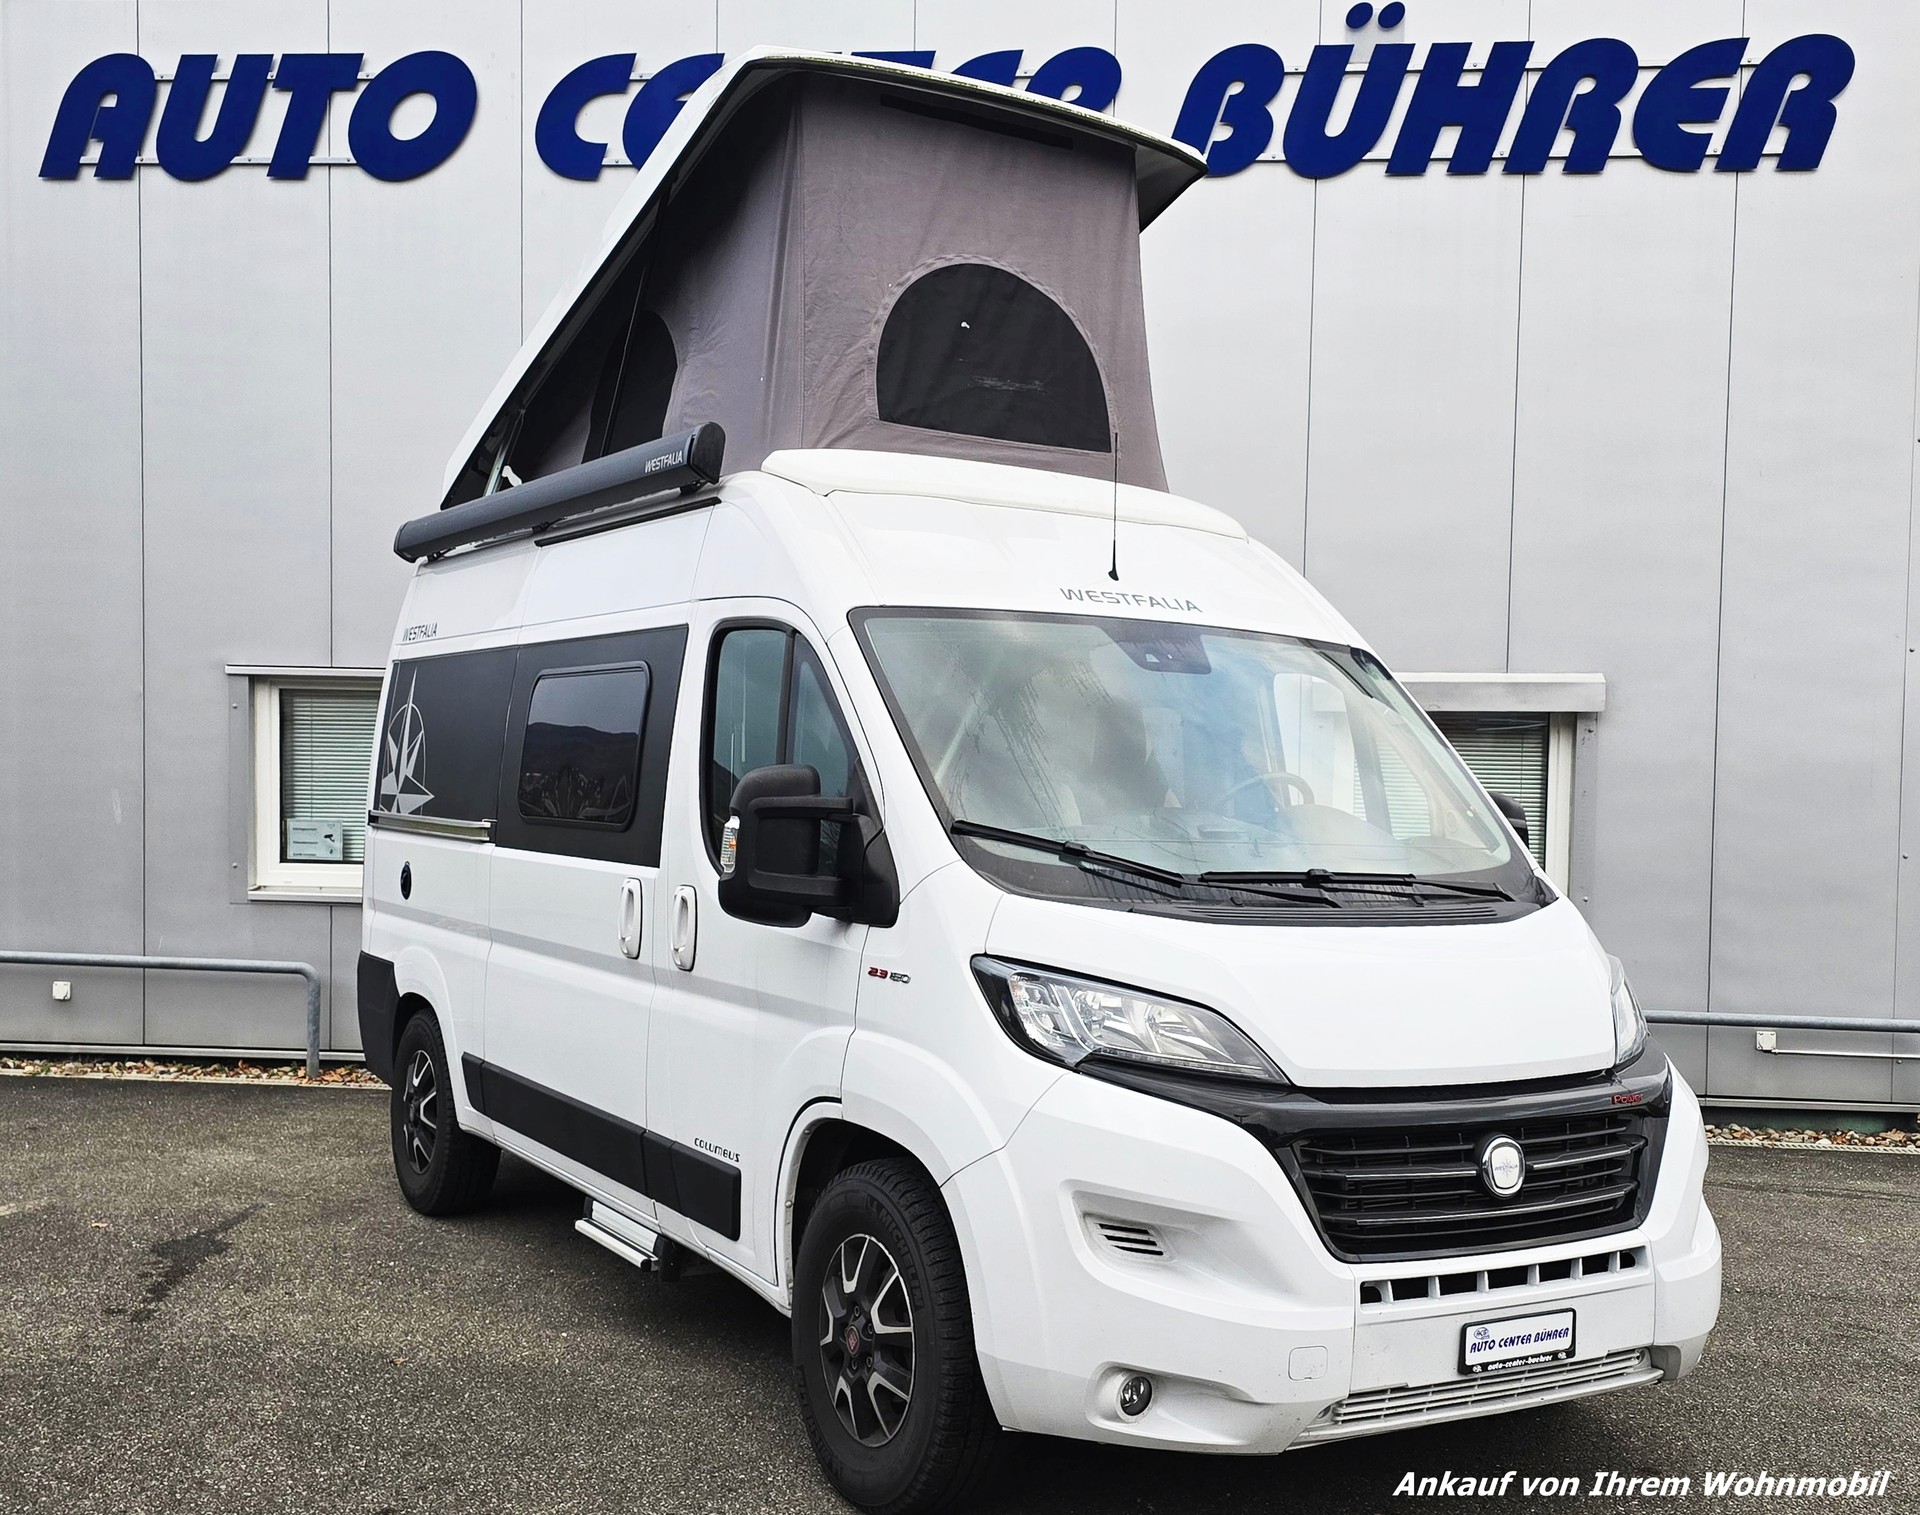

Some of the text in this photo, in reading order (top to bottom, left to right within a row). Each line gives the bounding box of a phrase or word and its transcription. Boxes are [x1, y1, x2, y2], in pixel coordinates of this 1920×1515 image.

[38, 50, 477, 182] AUTO
[1171, 1, 1855, 179] BÜHRER
[644, 450, 683, 474] WESTFALIA
[1059, 587, 1204, 614] WESTFALIA
[402, 622, 438, 642] WESTFALIA
[694, 1137, 741, 1163] COLUMBUS
[1470, 1339, 1496, 1354] AUTO
[1498, 1333, 1532, 1348] CENTER
